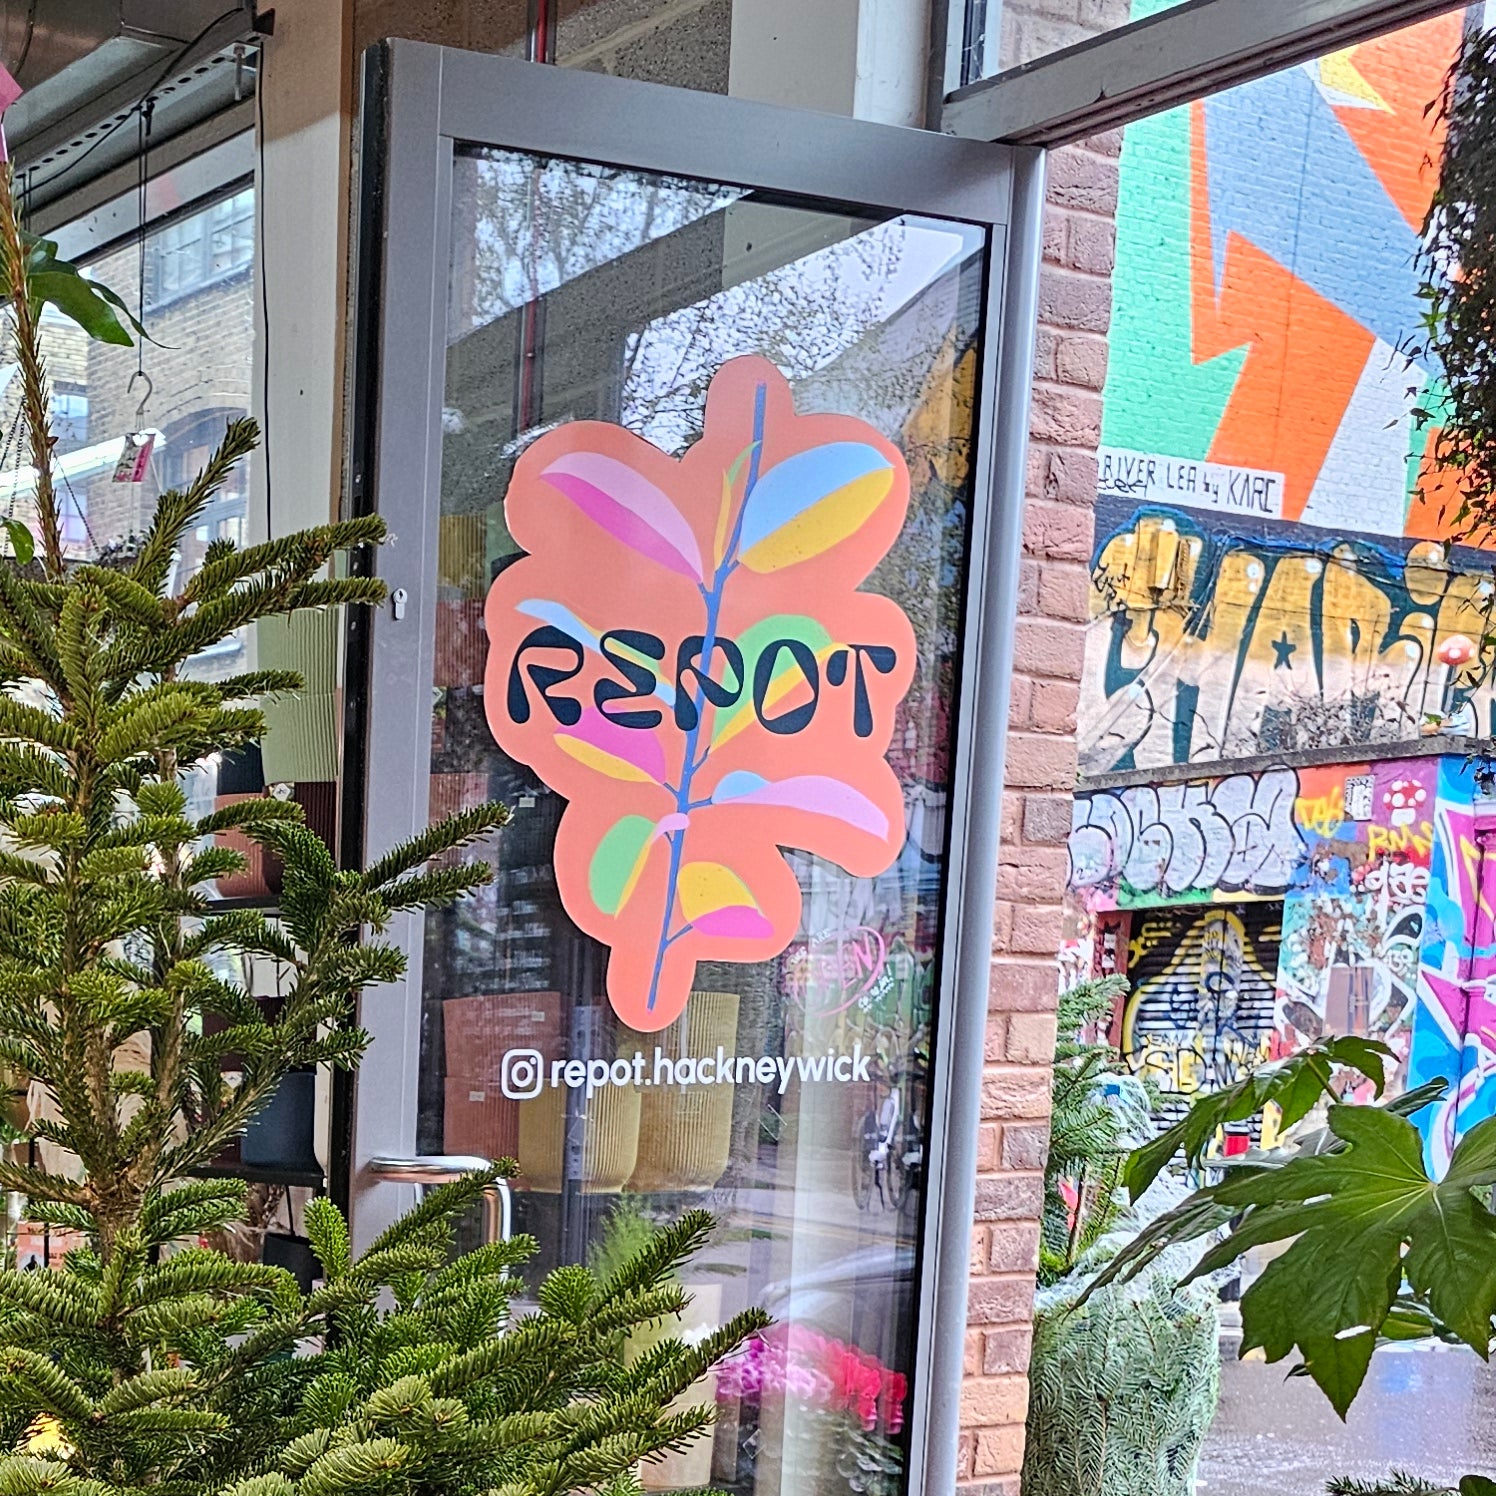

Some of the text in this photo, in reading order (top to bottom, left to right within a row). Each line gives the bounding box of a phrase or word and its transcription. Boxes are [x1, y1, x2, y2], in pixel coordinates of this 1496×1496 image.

[1103, 454, 1156, 486] RIVER
[1166, 462, 1197, 493] LEA
[507, 624, 897, 738] REPOT
[550, 1044, 872, 1099] repot.hackneywick
